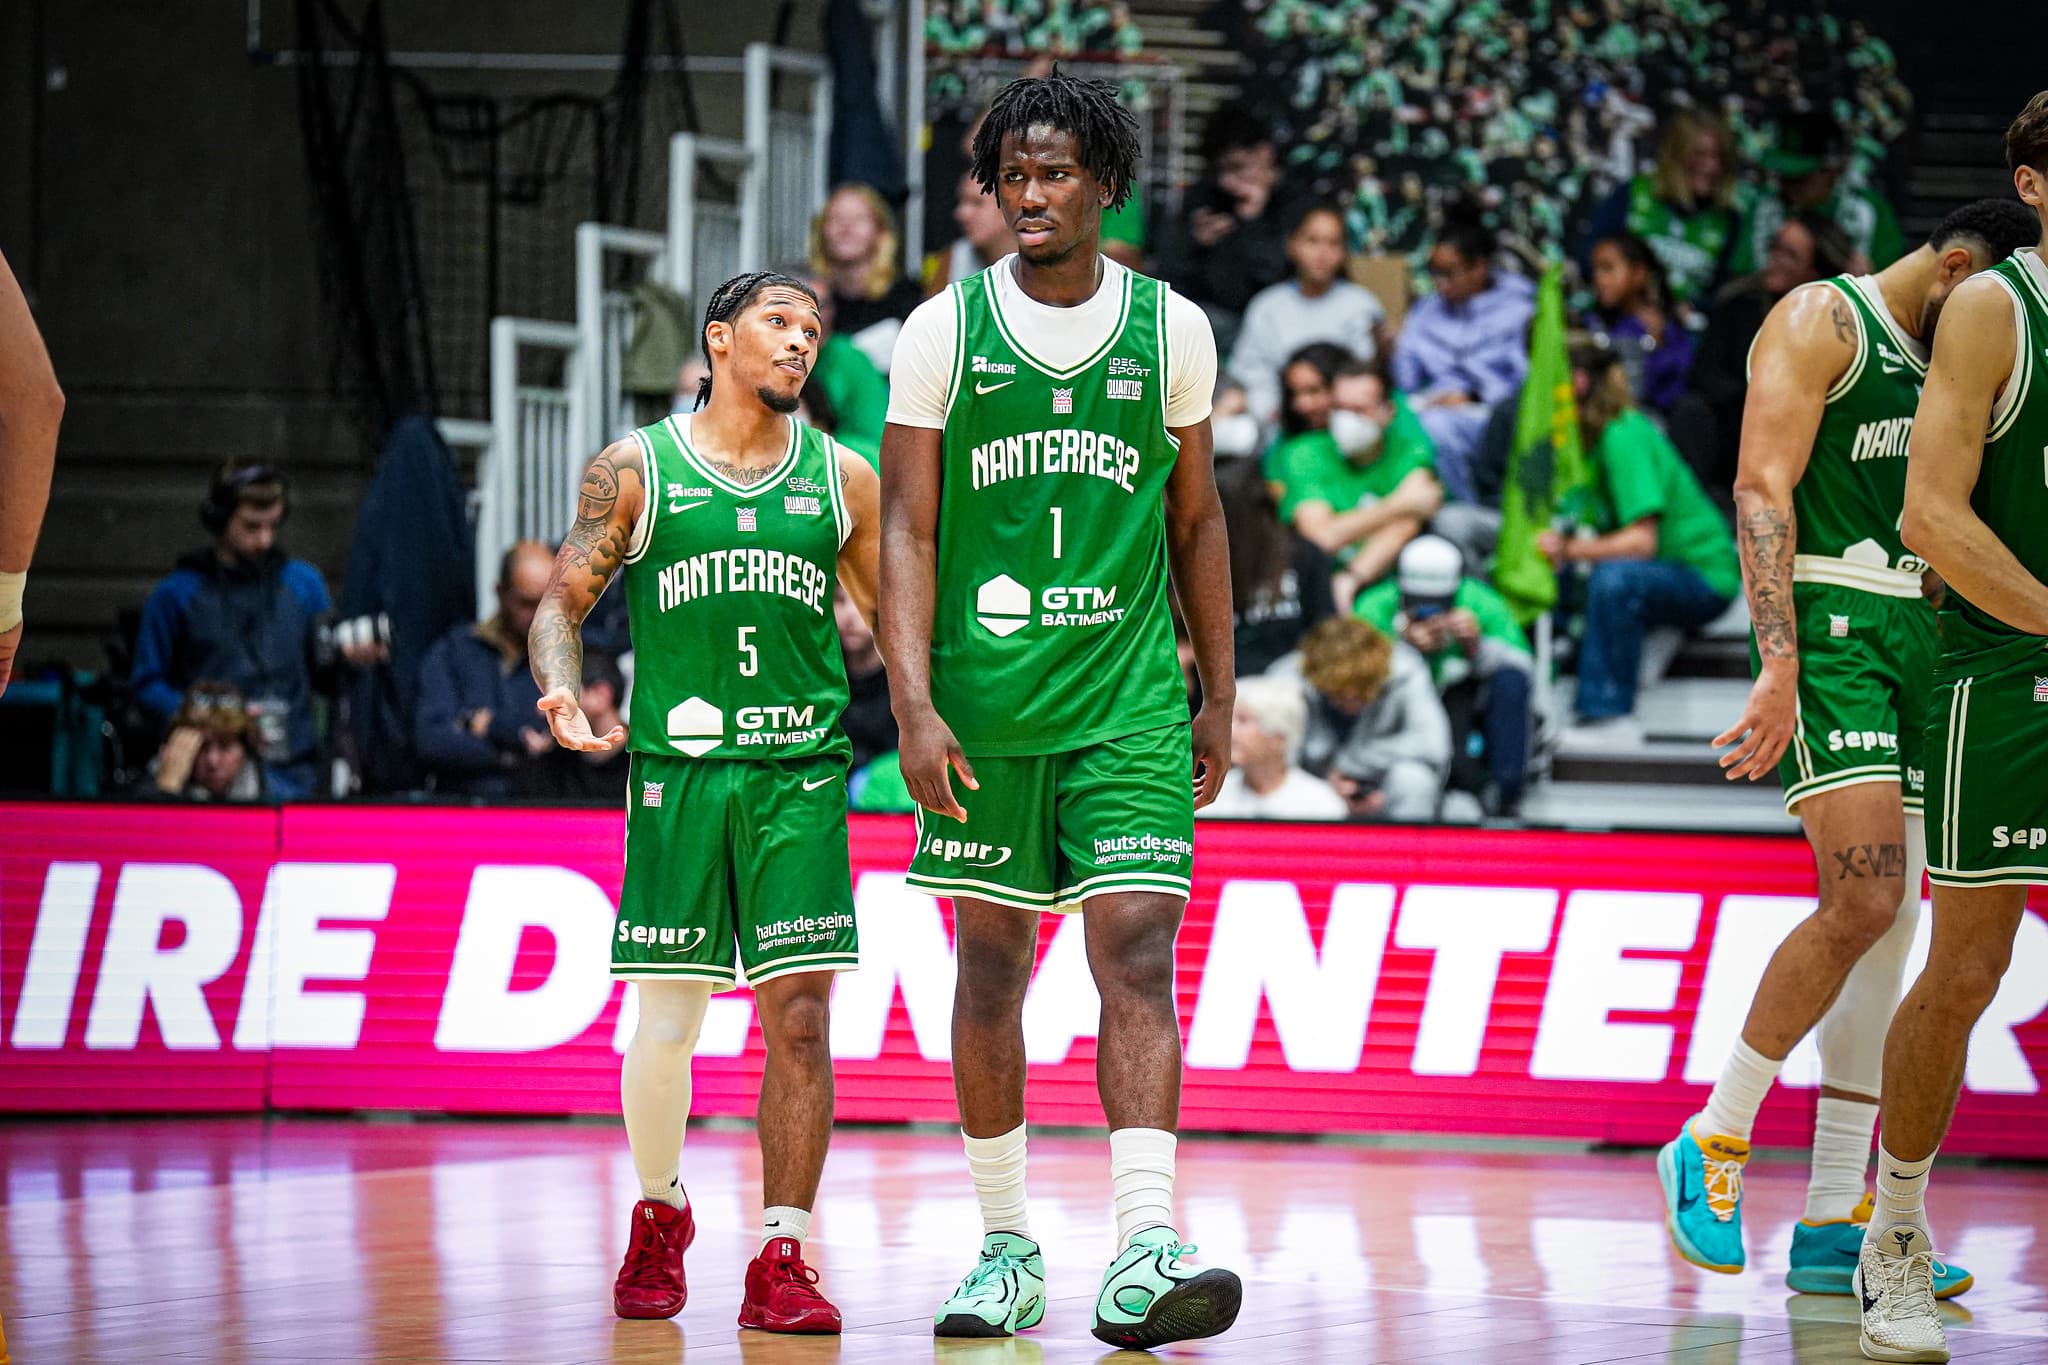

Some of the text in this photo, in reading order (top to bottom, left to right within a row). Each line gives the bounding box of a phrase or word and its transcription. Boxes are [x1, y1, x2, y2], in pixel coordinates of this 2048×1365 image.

[987, 363, 1016, 374] ICADE
[1108, 366, 1151, 377] SPORT
[1107, 379, 1142, 396] QUARTUS
[1851, 417, 1914, 462] NANT
[683, 487, 713, 497] ICADE
[788, 485, 827, 494] SPORT
[784, 496, 821, 512] QUARTUS
[1050, 507, 1062, 559] 1
[1042, 585, 1117, 610] GTM
[738, 626, 758, 677] 5
[736, 705, 814, 730] GTM
[1828, 729, 1897, 752] Sepur
[1094, 851, 1181, 865] Département Sportif
[618, 919, 690, 949] Sepur
[758, 930, 836, 952] Département Sportif
[10, 860, 398, 1051] IRE
